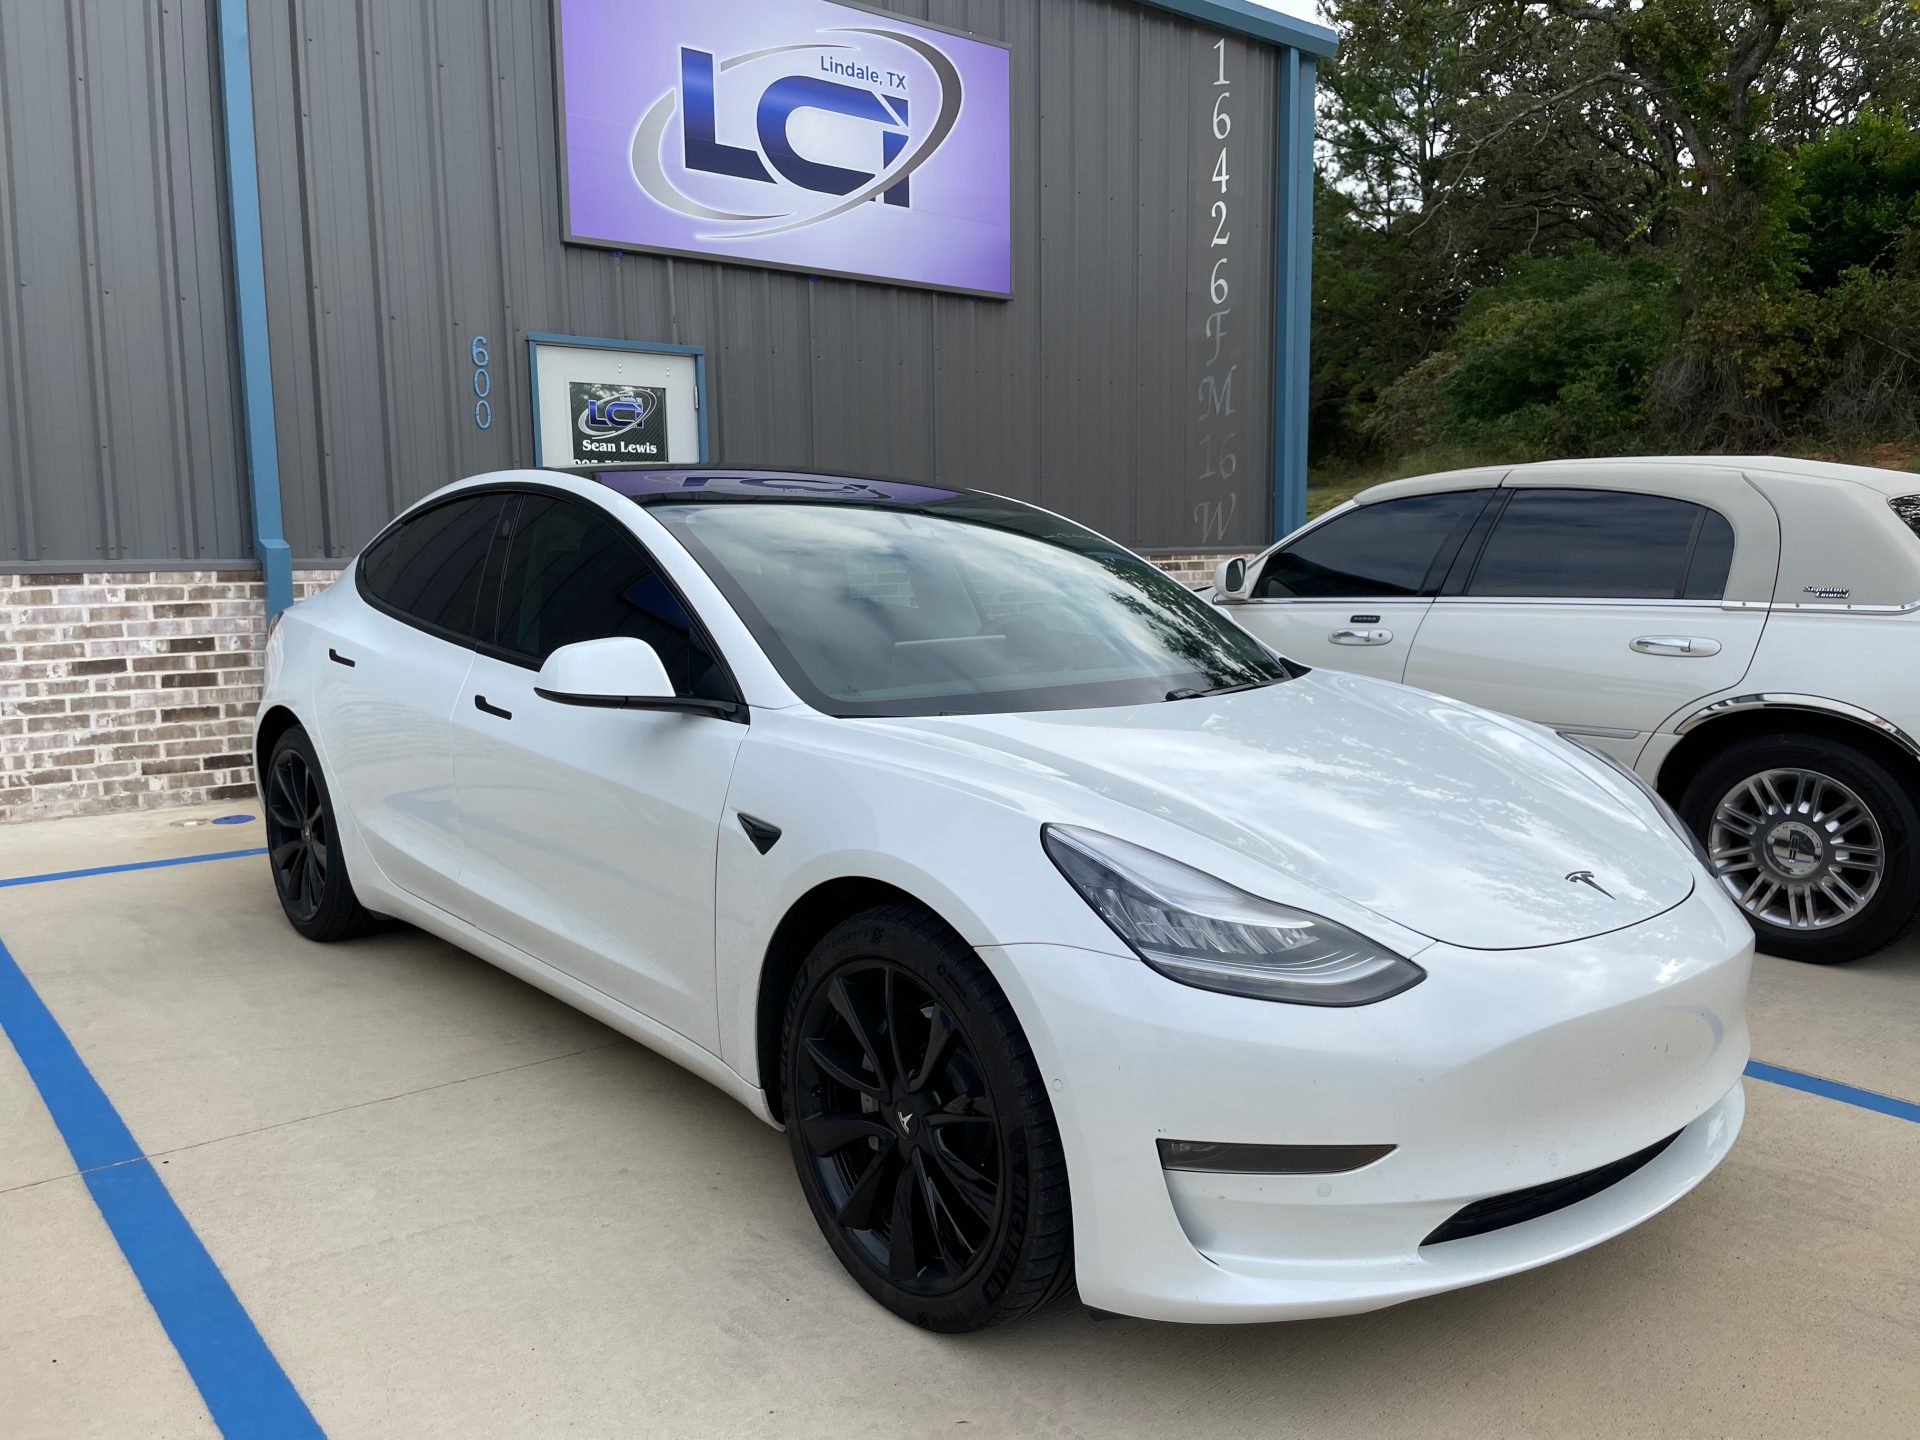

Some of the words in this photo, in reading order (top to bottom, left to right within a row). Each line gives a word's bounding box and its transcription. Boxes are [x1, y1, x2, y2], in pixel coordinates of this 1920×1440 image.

[820, 55, 883, 86] Lindale,
[886, 71, 906, 90] TX
[1210, 38, 1232, 304] 16426
[471, 335, 492, 430] 600
[582, 439, 616, 452] Sean
[620, 441, 657, 454] Lewis
[1199, 432, 1237, 480] 16
[1194, 492, 1237, 543] W
[983, 1166, 1028, 1305] MICHELIN
